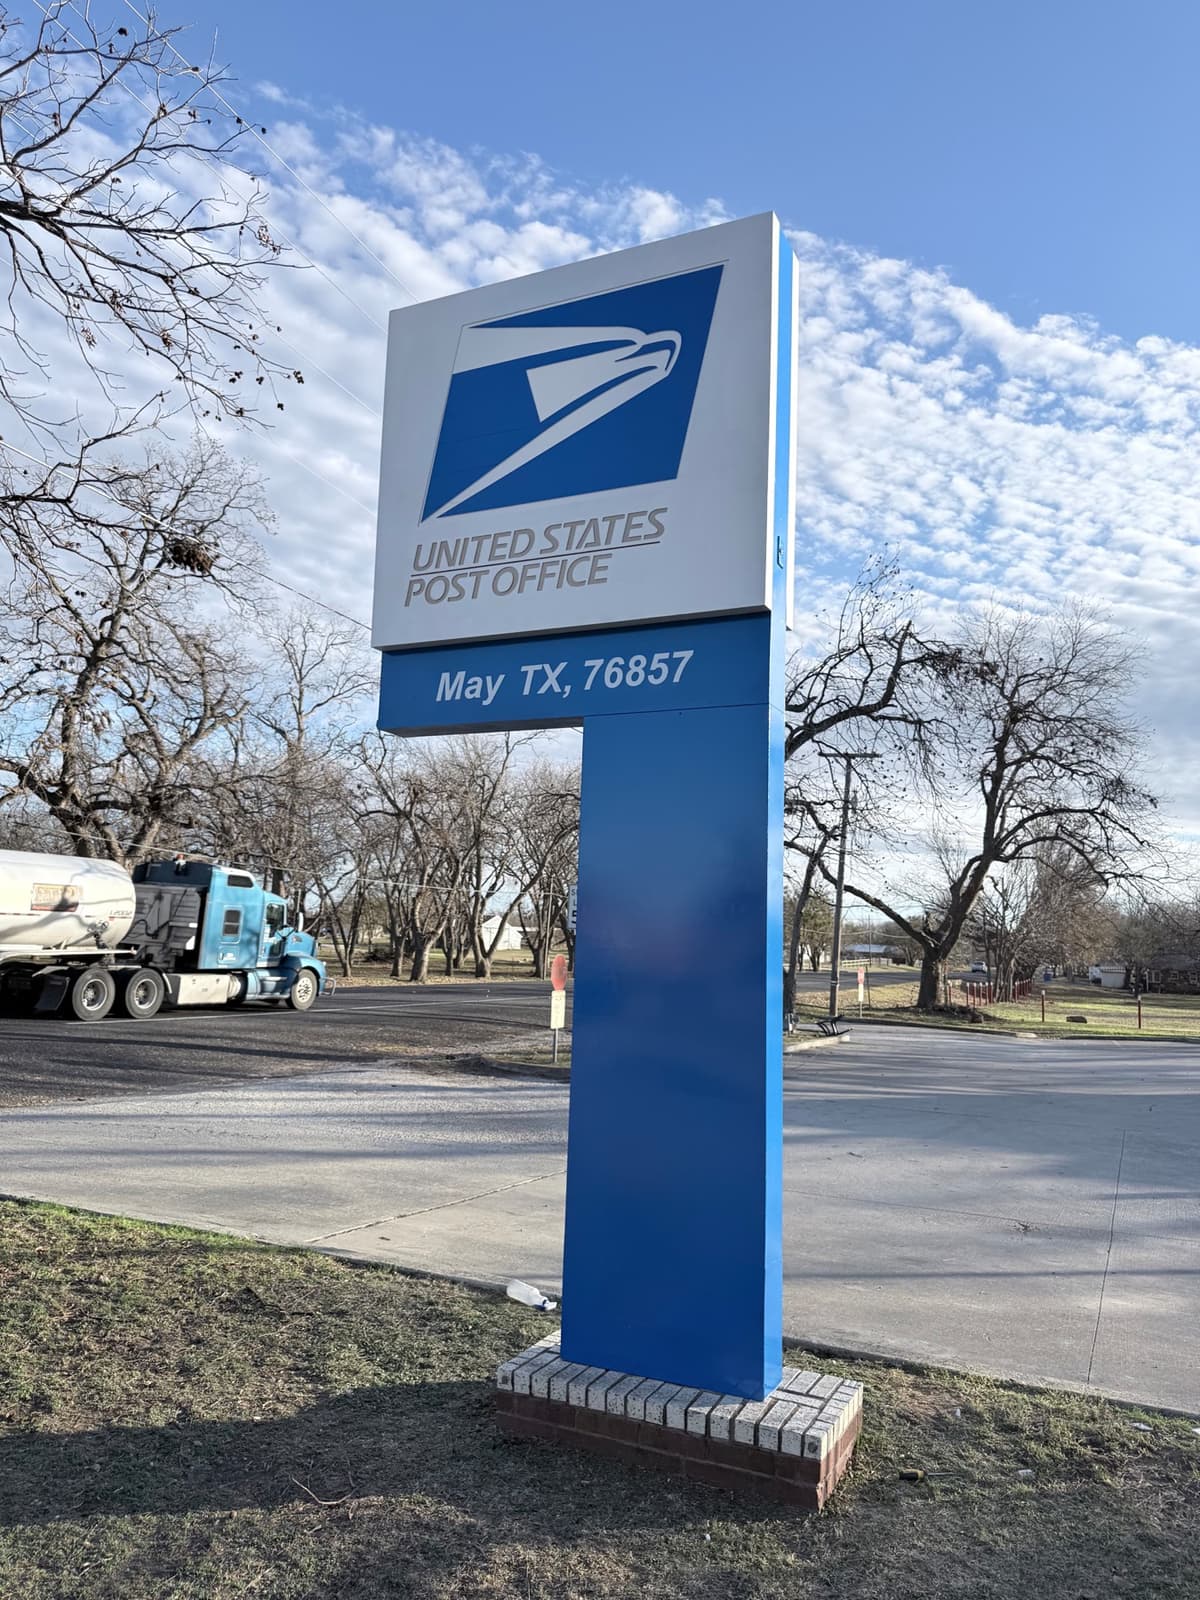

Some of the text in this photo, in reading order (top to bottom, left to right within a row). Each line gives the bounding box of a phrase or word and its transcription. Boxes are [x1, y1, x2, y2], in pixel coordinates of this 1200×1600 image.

[412, 507, 668, 572] UNITED STATES
[404, 553, 613, 607] POST OFFICE
[435, 650, 695, 706] May TX, 76857
